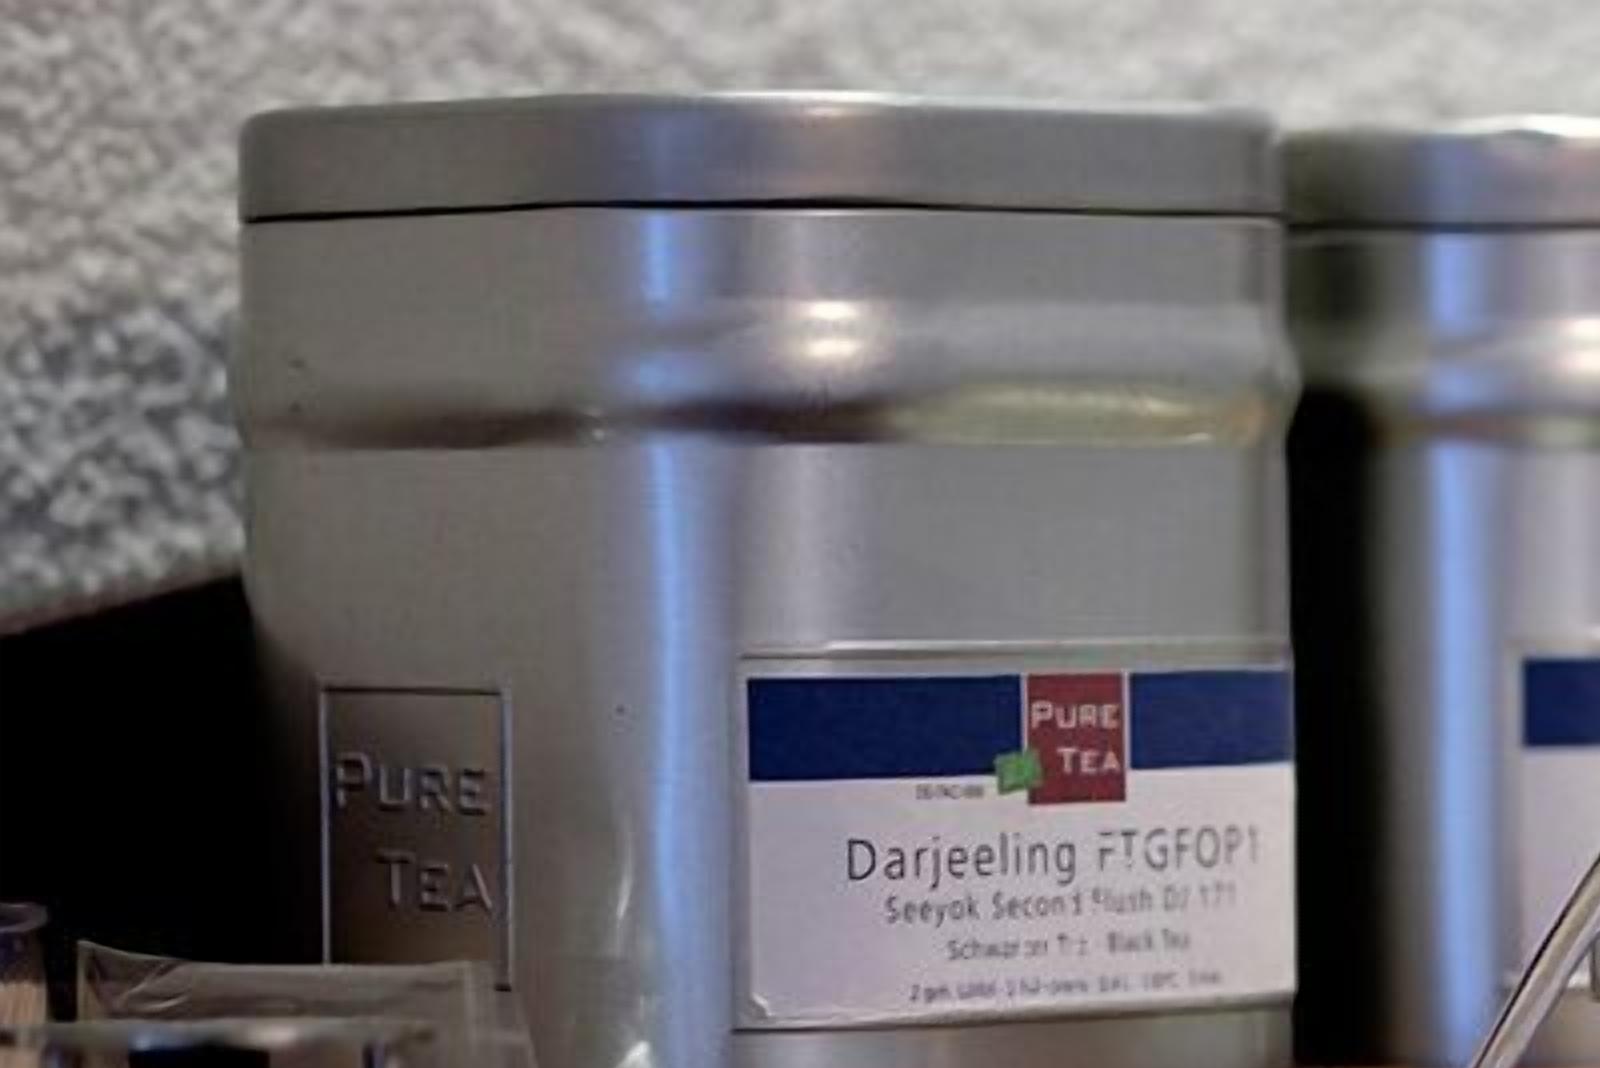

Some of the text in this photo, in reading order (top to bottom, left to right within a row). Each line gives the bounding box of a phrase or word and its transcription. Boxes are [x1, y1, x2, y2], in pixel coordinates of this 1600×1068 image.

[1031, 701, 1120, 730] PURE
[1057, 747, 1120, 775] TEA
[334, 752, 493, 817] PURE
[374, 849, 494, 912] TEA
[847, 831, 1076, 890] Darjeeling
[885, 896, 979, 928] Seeyok
